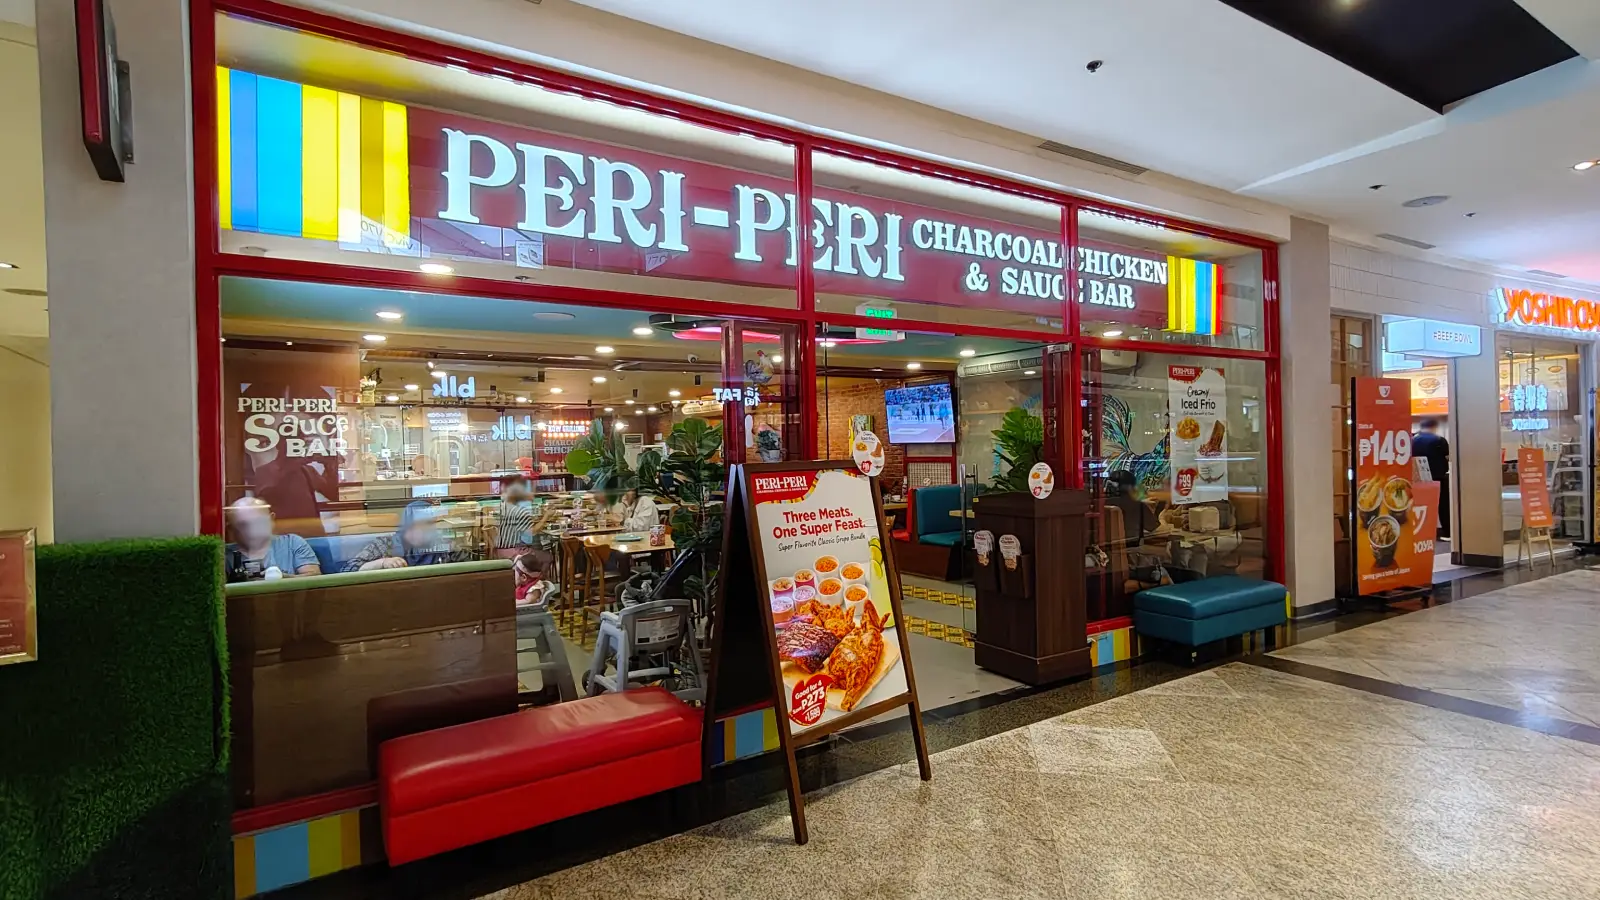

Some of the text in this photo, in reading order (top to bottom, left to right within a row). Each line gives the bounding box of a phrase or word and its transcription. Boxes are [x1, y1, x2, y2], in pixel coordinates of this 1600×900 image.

[438, 128, 904, 281] PERI-PERI
[912, 218, 1167, 285] CHARCOAL CHICKEN
[965, 262, 1136, 309] & SAUC BAR
[1454, 332, 1472, 344] BOWL
[238, 397, 337, 413] PERI-PERI
[1181, 398, 1216, 410] Iced Frio
[286, 438, 348, 458] BAR
[755, 475, 807, 490] PERI-PERI
[783, 507, 853, 524] Three Meats.
[773, 517, 866, 539] One Super Feast.
[778, 542, 793, 552] Super
[817, 536, 835, 547] Classic
[795, 687, 810, 700] Good
[810, 683, 818, 691] for
